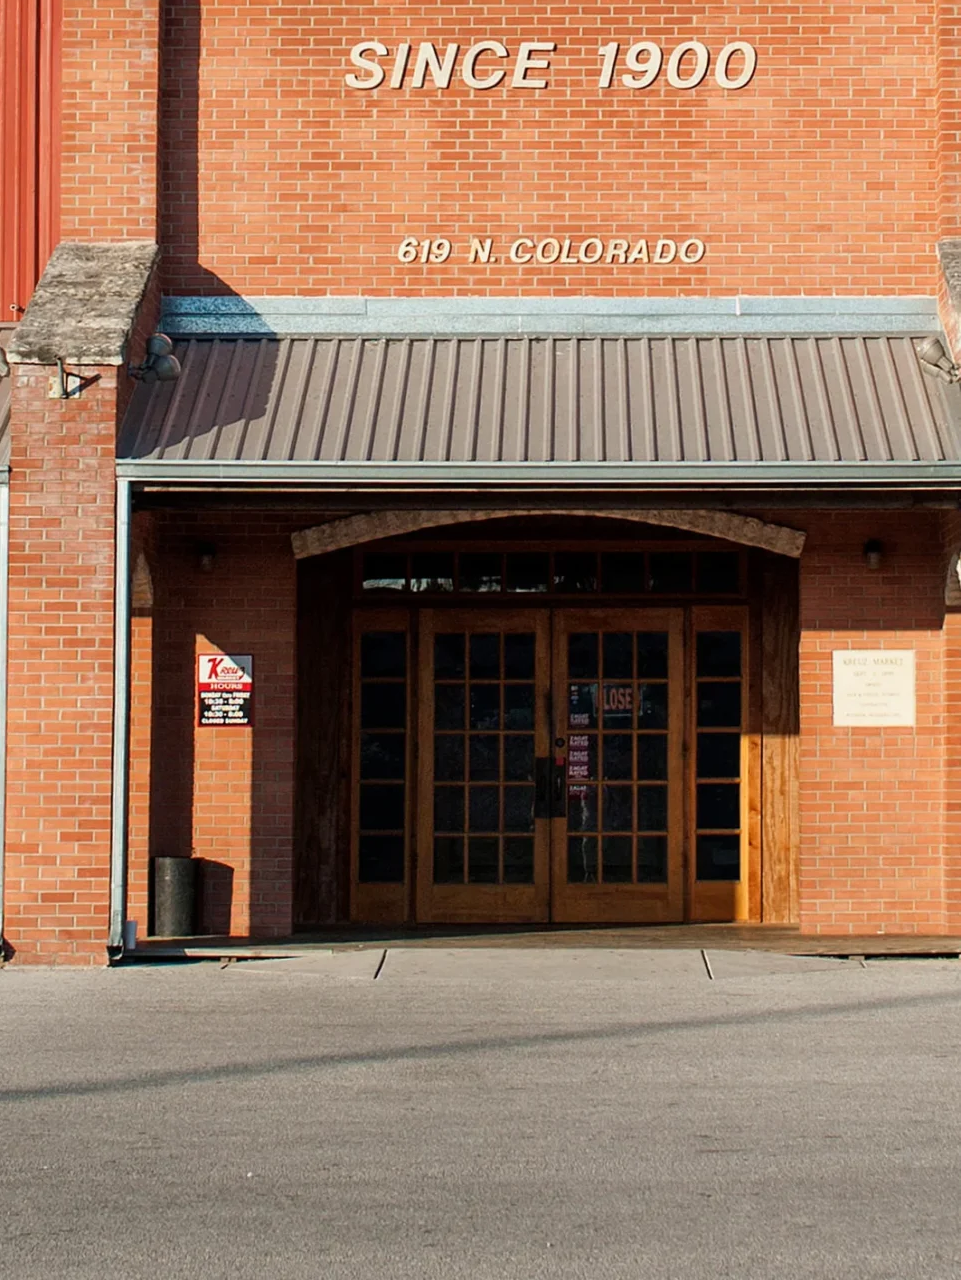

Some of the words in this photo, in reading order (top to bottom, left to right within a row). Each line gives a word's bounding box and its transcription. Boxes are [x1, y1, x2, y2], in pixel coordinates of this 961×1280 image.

[344, 41, 557, 90] SINCE
[597, 40, 758, 90] 1900
[397, 237, 452, 263] 619
[468, 238, 498, 263] N.
[509, 237, 706, 264] COLORADO
